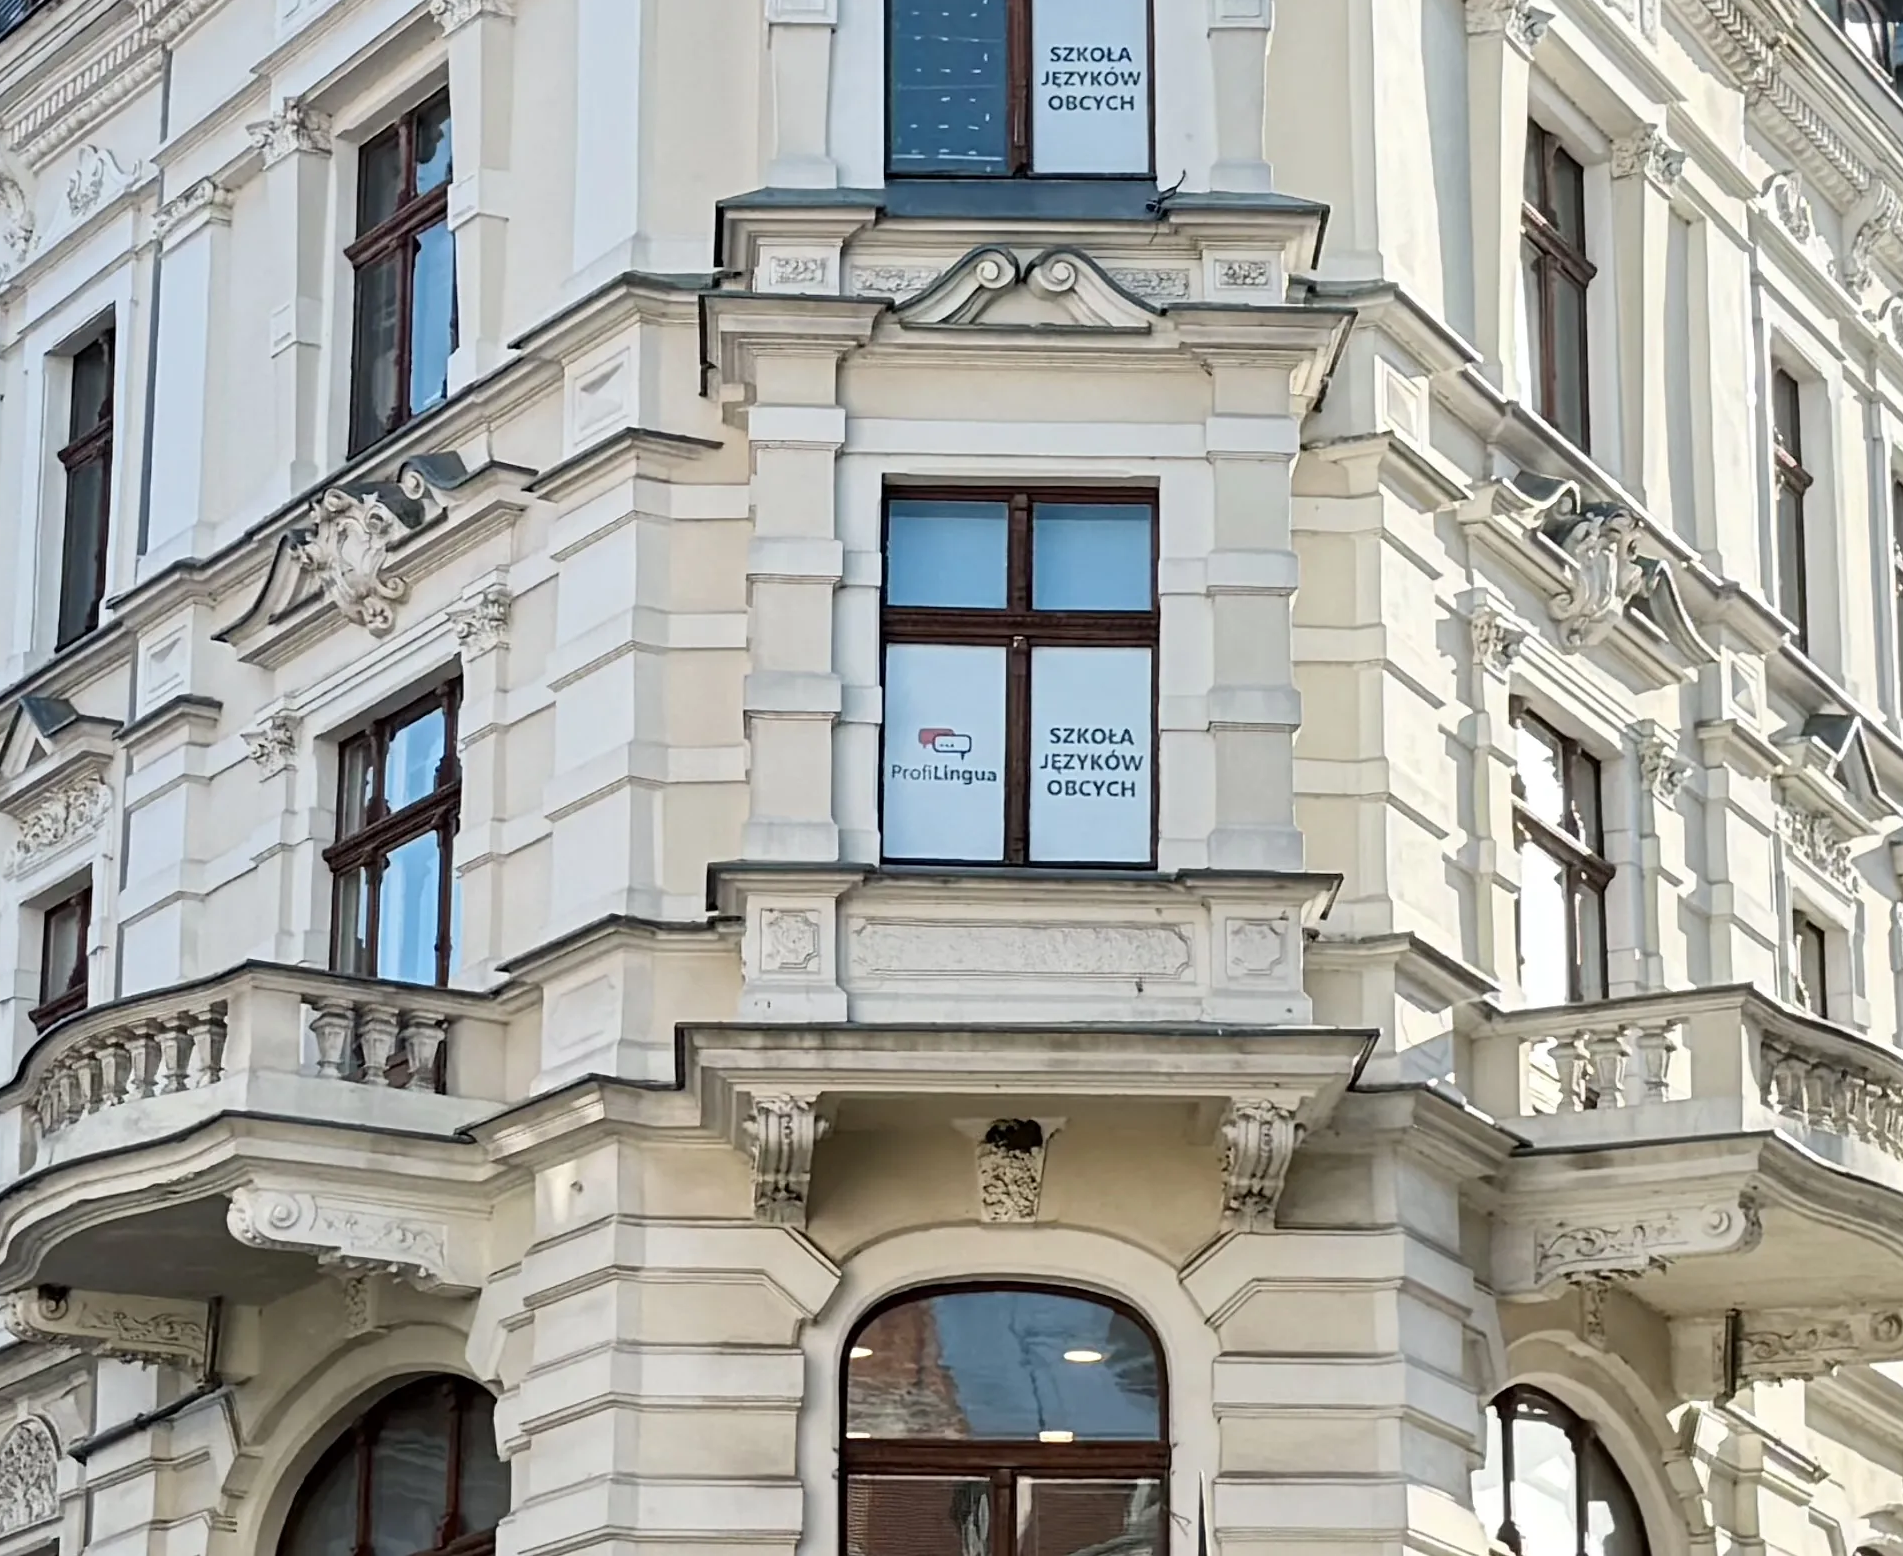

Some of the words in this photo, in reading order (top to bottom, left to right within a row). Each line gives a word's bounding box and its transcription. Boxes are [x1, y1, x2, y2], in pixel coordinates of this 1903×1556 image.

[1049, 46, 1133, 63] SZKOŁA
[1040, 66, 1142, 88] JĘZYKÓW
[1047, 94, 1135, 112] OBCYCH
[1049, 727, 1135, 746] SZKOŁA
[1038, 749, 1144, 775] JĘZYKÓW
[890, 763, 998, 786] ProfiLingua
[1046, 779, 1136, 798] OBCYCH
